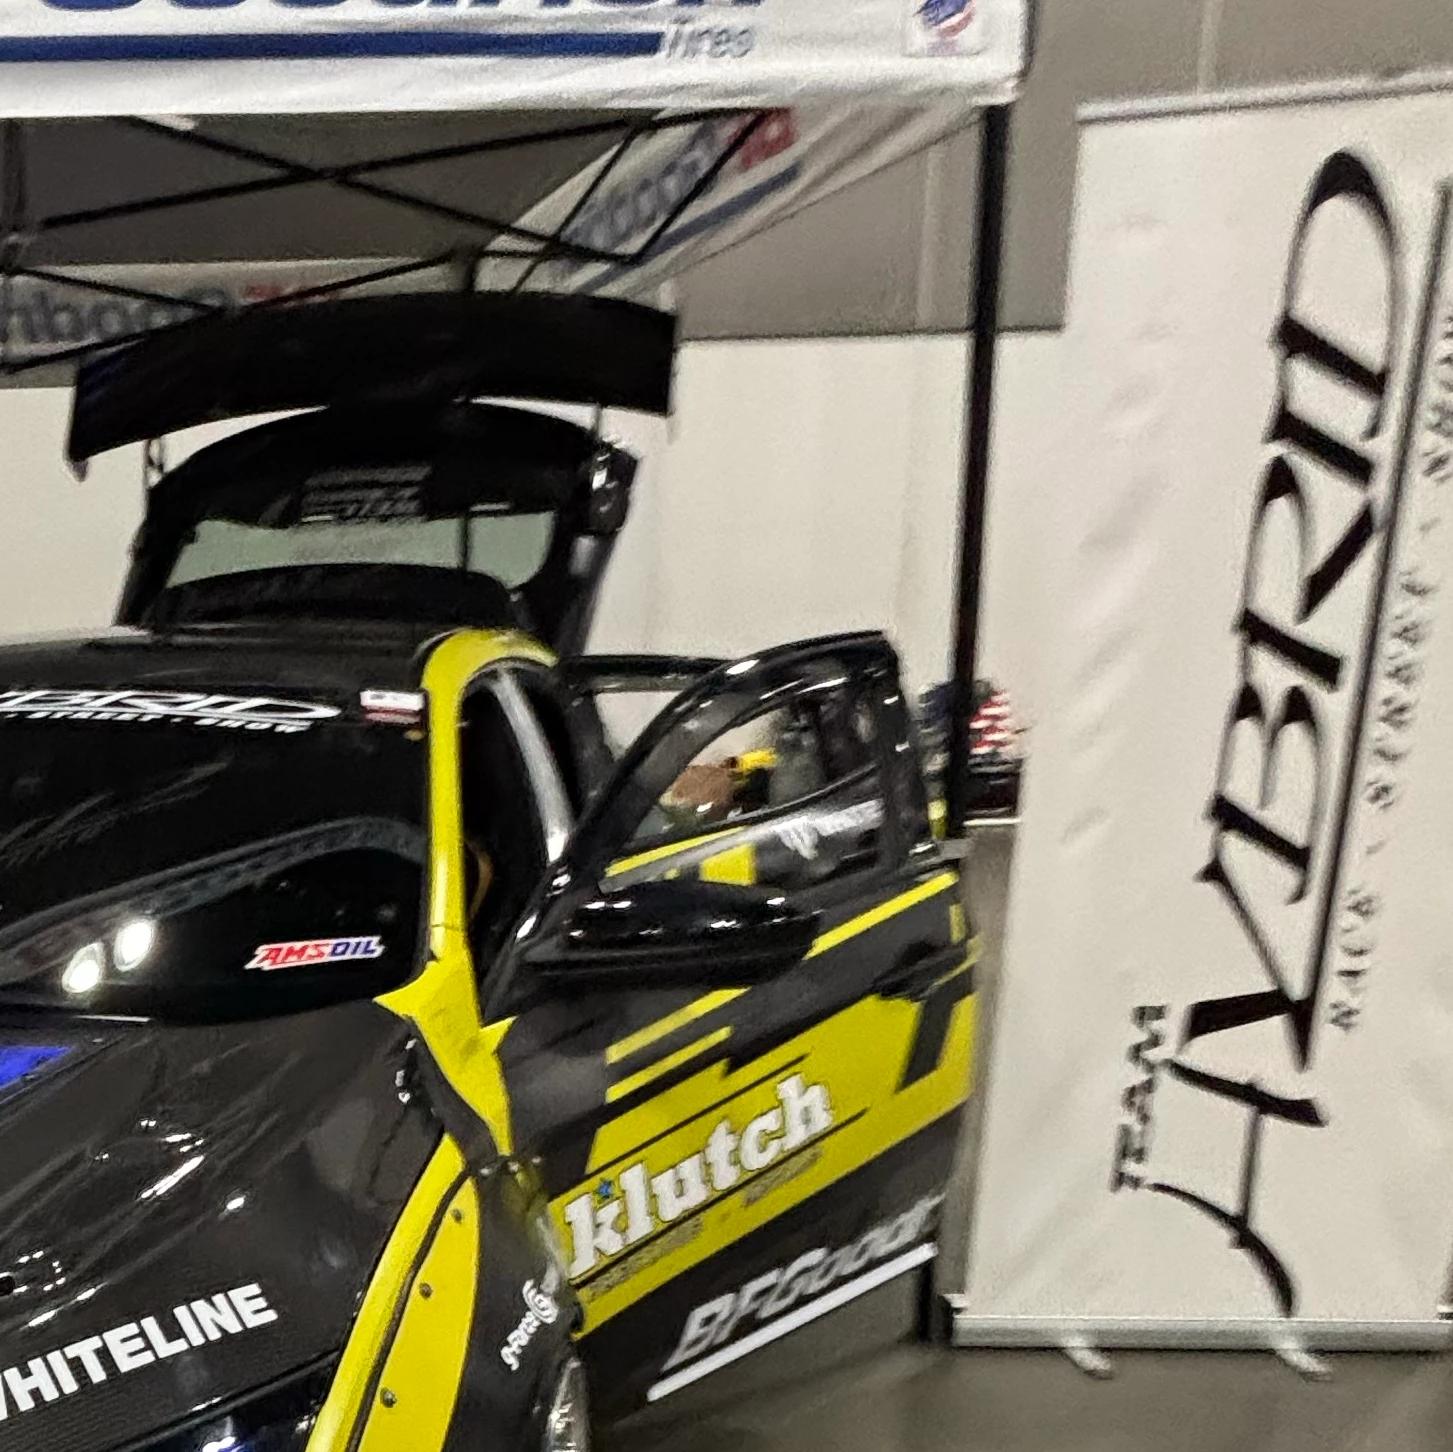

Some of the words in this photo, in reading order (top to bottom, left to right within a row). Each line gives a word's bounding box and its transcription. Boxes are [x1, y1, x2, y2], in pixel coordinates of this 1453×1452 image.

[1145, 146, 1403, 1317] HYBRID
[256, 939, 378, 967] AMSOIL
[564, 1071, 834, 1279] klutch
[1110, 1003, 1167, 1193] TEAM
